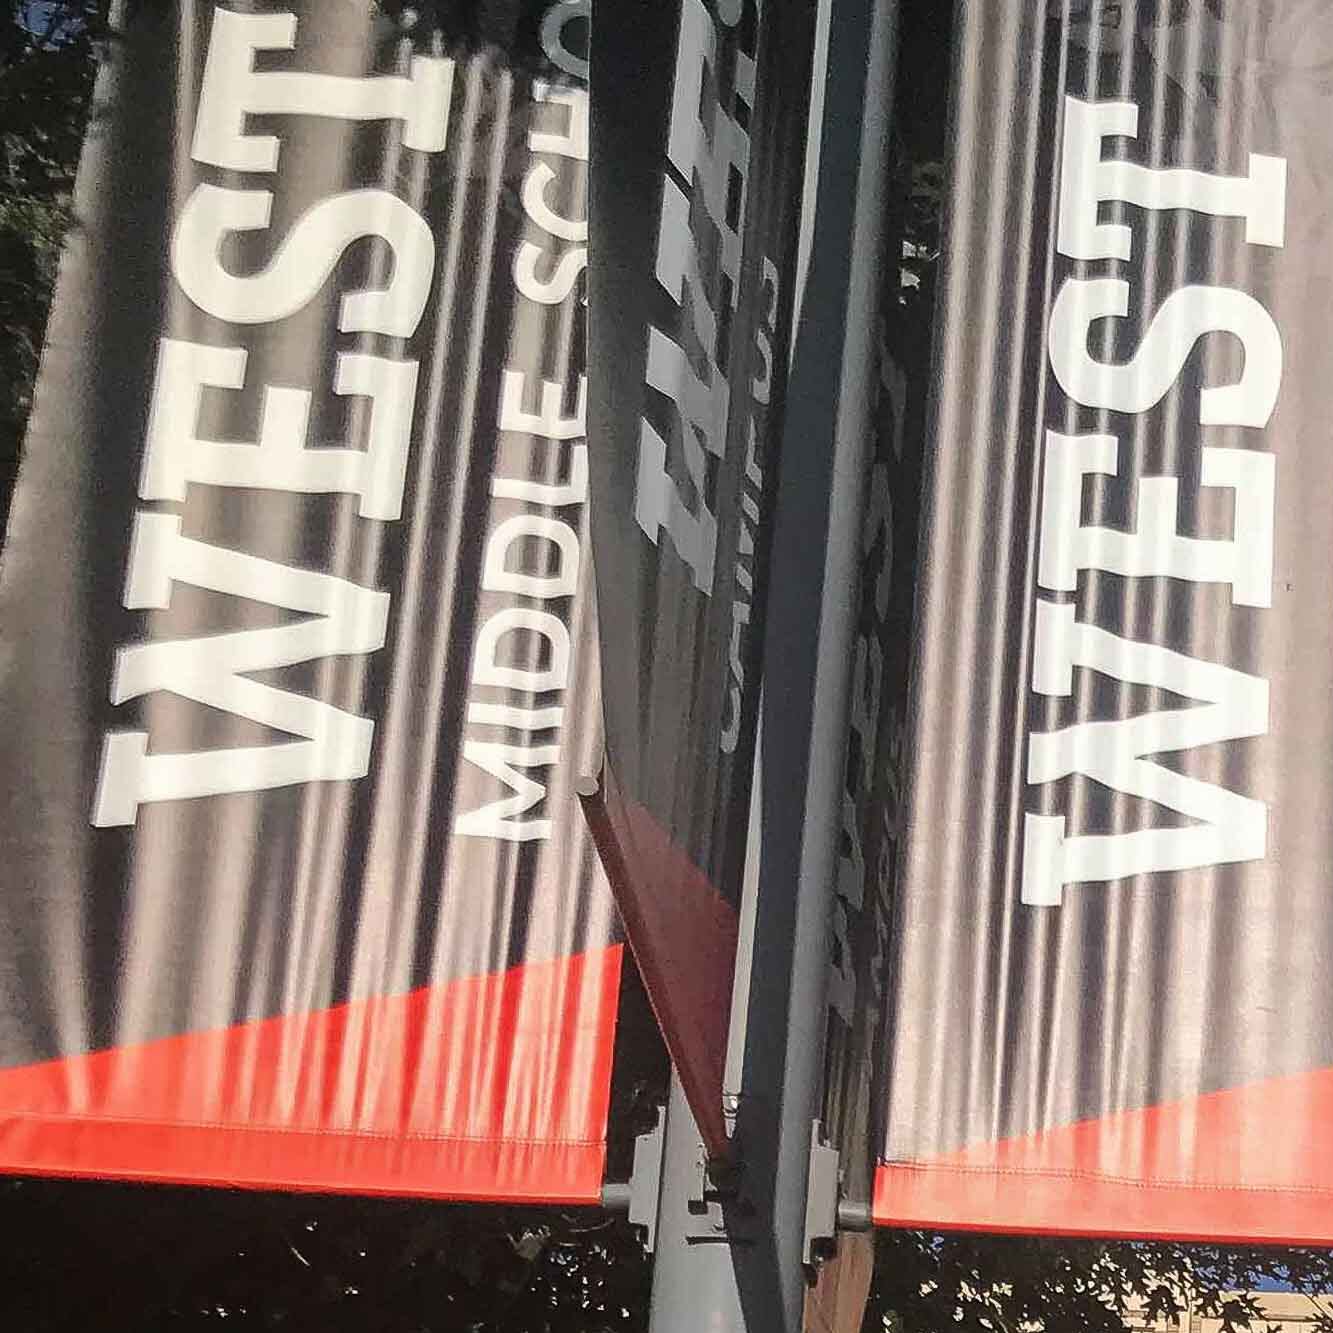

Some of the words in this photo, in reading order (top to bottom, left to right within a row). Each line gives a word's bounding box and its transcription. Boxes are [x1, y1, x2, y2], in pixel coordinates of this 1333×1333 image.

[90, 9, 455, 828] WEST
[454, 369, 589, 841] MIDDLE
[1022, 94, 1287, 907] WEST
